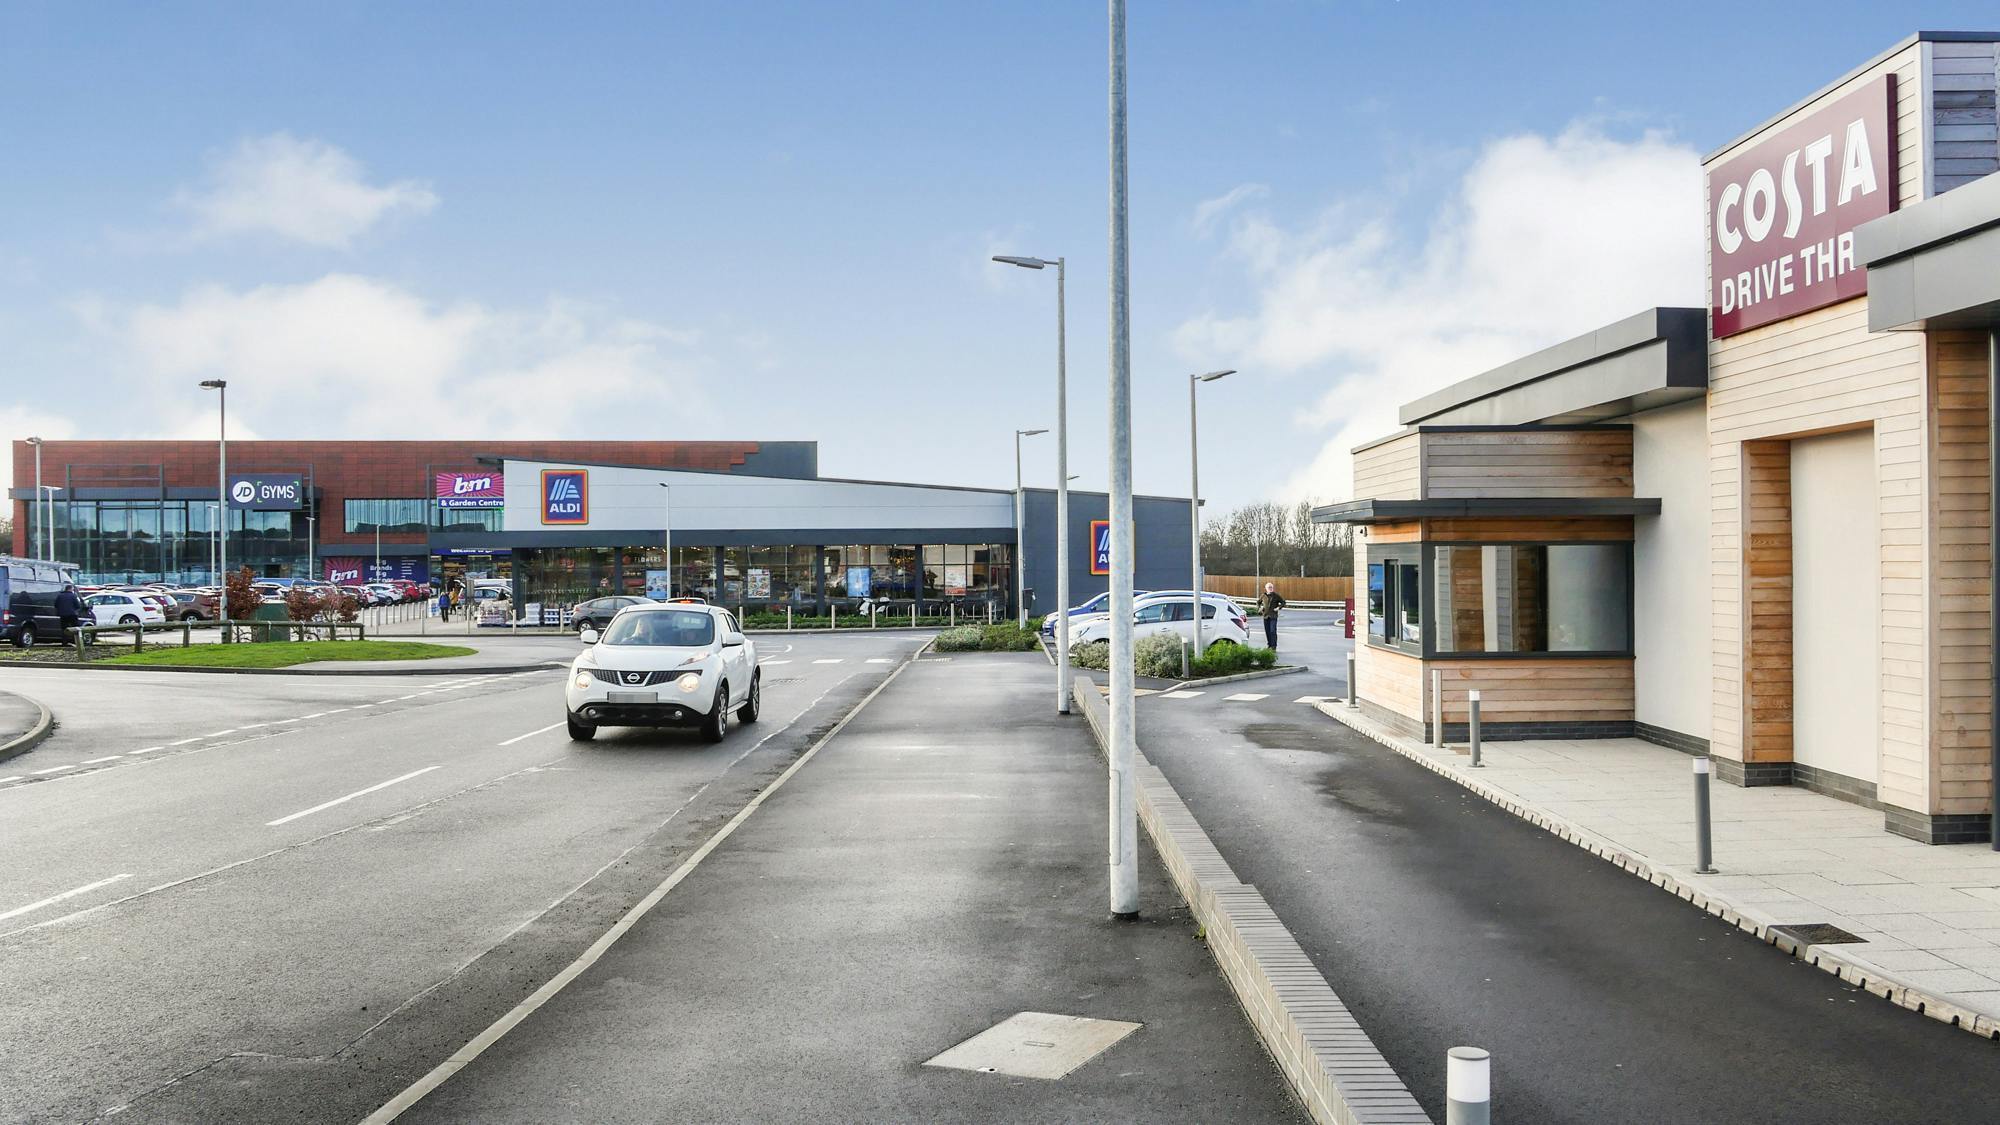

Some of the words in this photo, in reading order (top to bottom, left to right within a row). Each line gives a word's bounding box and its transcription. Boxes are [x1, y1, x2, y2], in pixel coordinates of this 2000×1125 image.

[1716, 118, 1877, 254] COSTA
[1721, 254, 1794, 315] DRIVE
[1800, 230, 1856, 288] THR
[236, 486, 252, 498] JD
[261, 485, 295, 499] GYMS
[449, 499, 477, 507] Garden
[478, 499, 504, 507] Centre
[549, 503, 581, 513] ALDI
